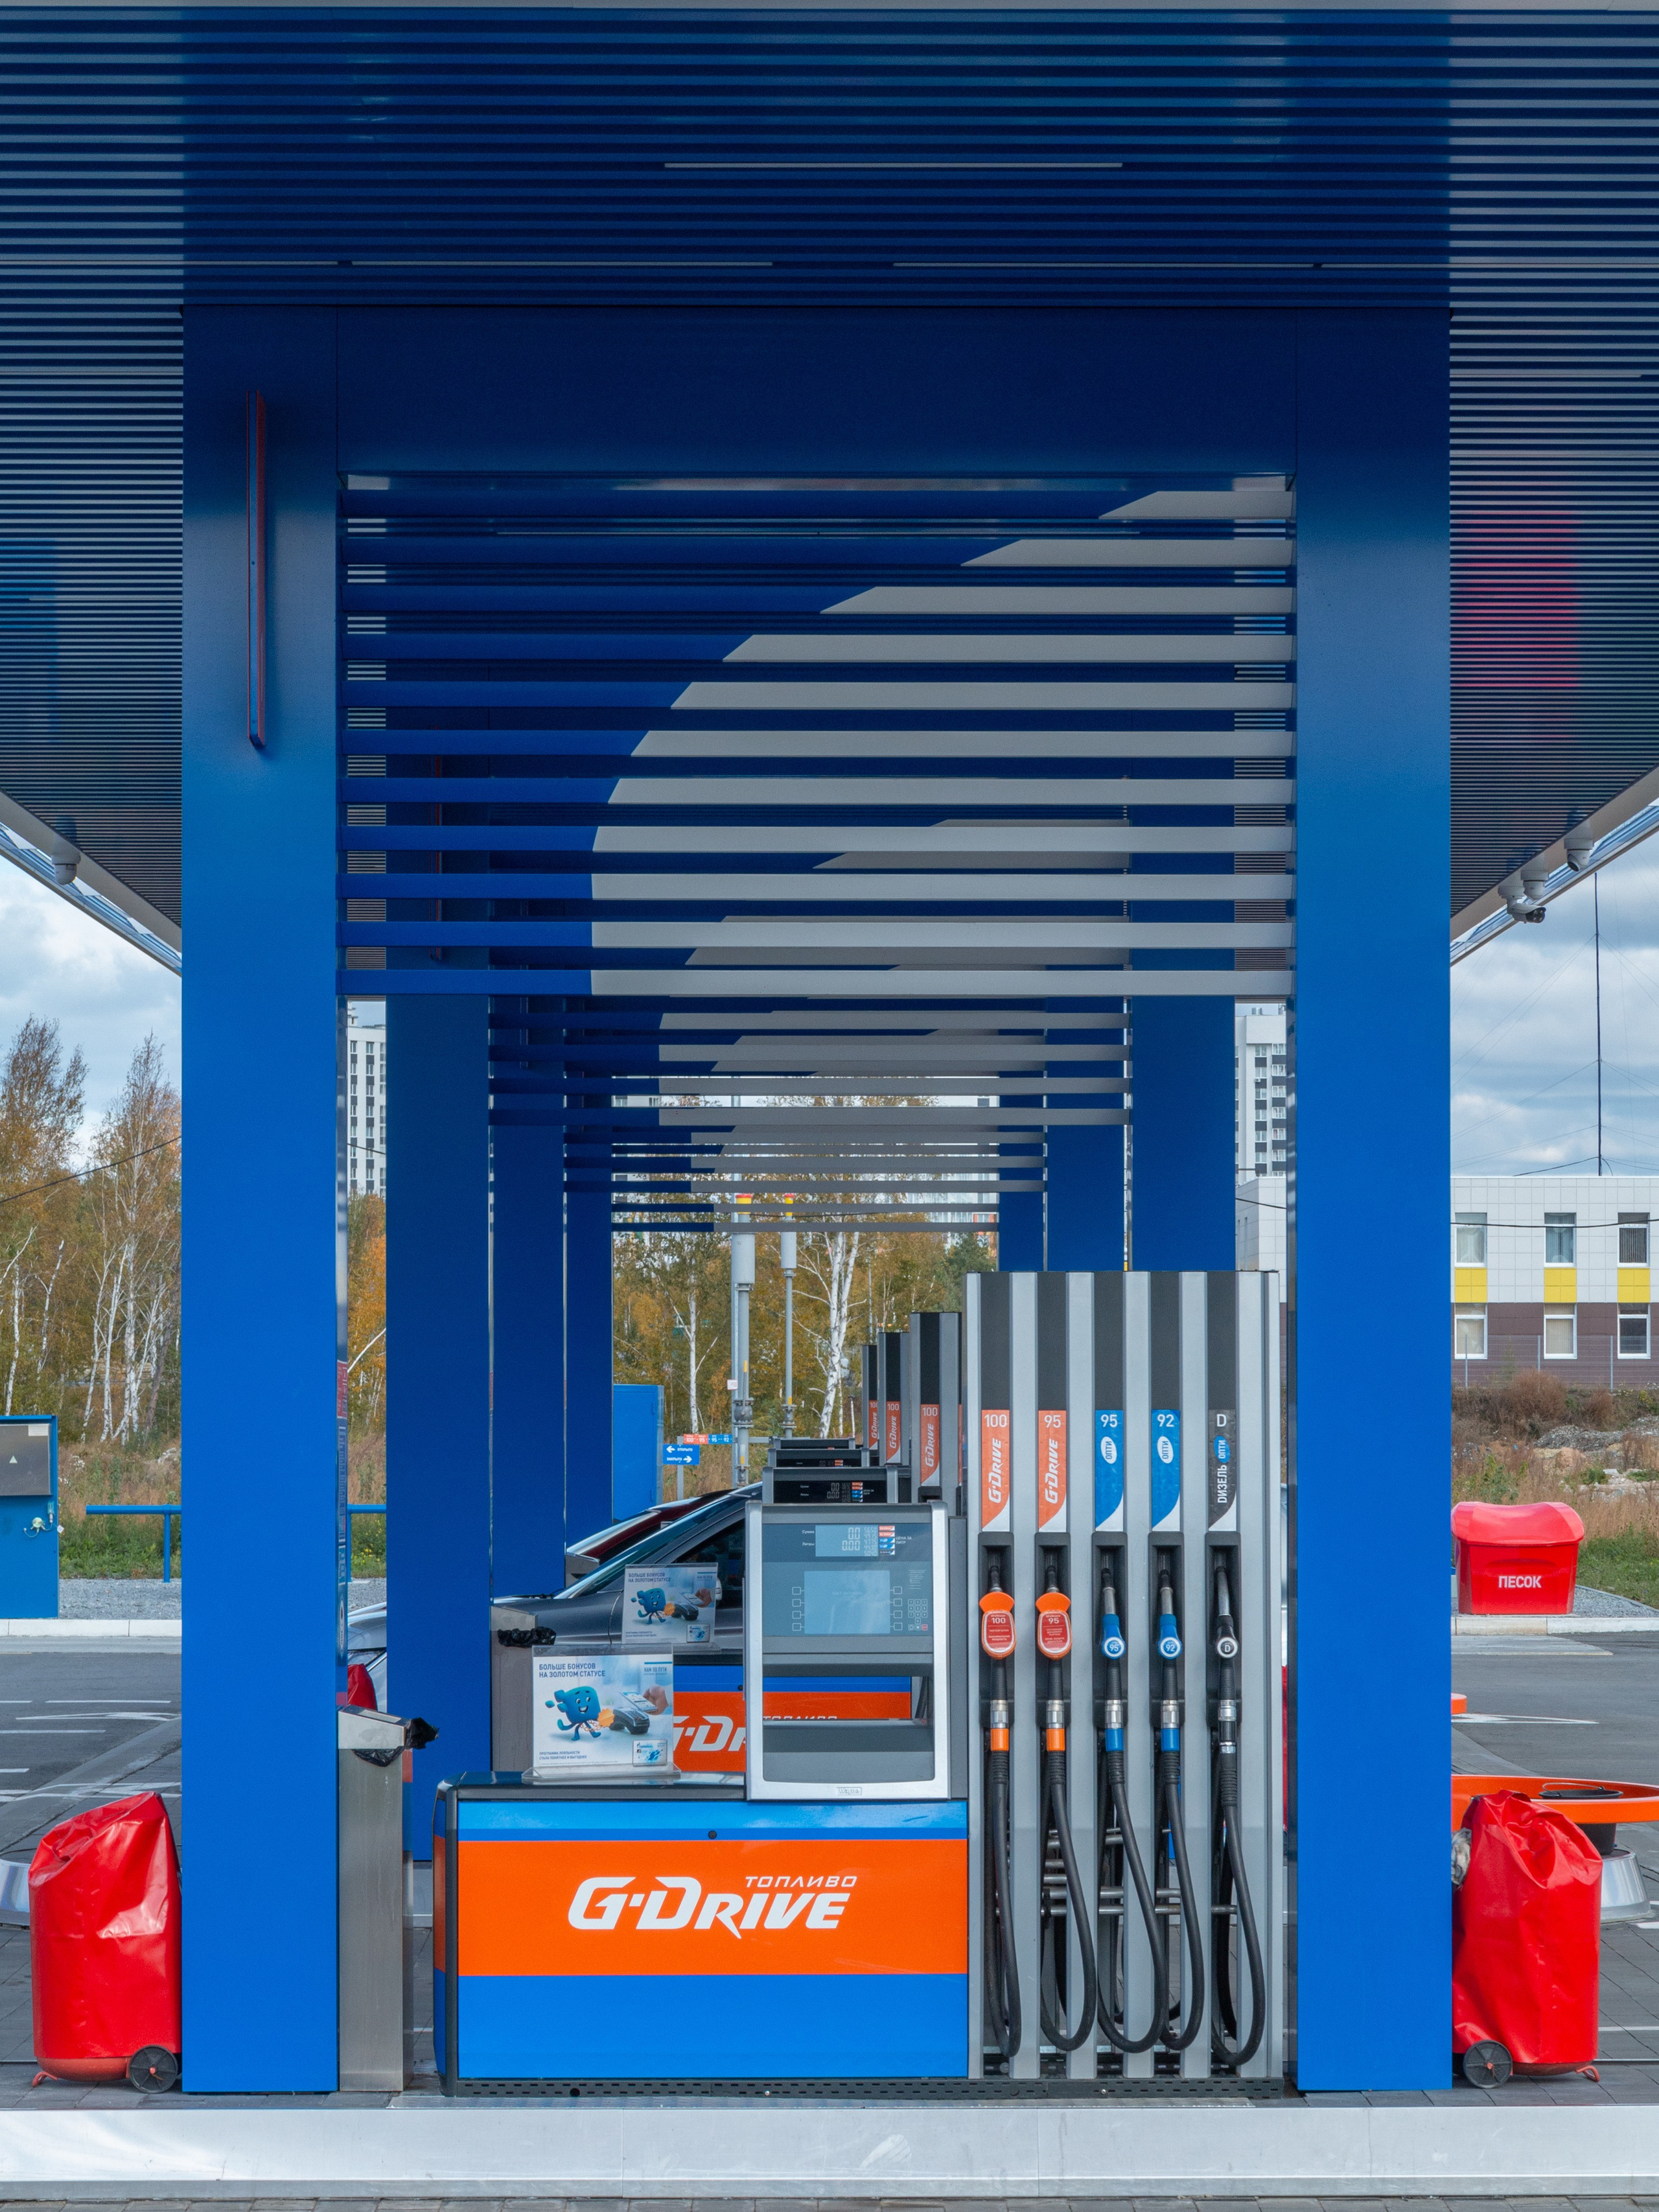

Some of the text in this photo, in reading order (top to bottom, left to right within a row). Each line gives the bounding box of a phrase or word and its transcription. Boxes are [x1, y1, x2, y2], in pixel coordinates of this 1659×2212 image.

[922, 1407, 938, 1416] 100
[984, 1414, 1007, 1427] 100
[1044, 1415, 1062, 1428] 95
[1101, 1414, 1118, 1427] 95
[1157, 1414, 1174, 1427] 92
[1216, 1414, 1227, 1427] D
[1498, 1575, 1542, 1589] ПЕСОК
[1224, 1644, 1231, 1653] D
[745, 1876, 857, 1887] ТОПЛИВО
[568, 1876, 851, 1939] G-DRIVE
